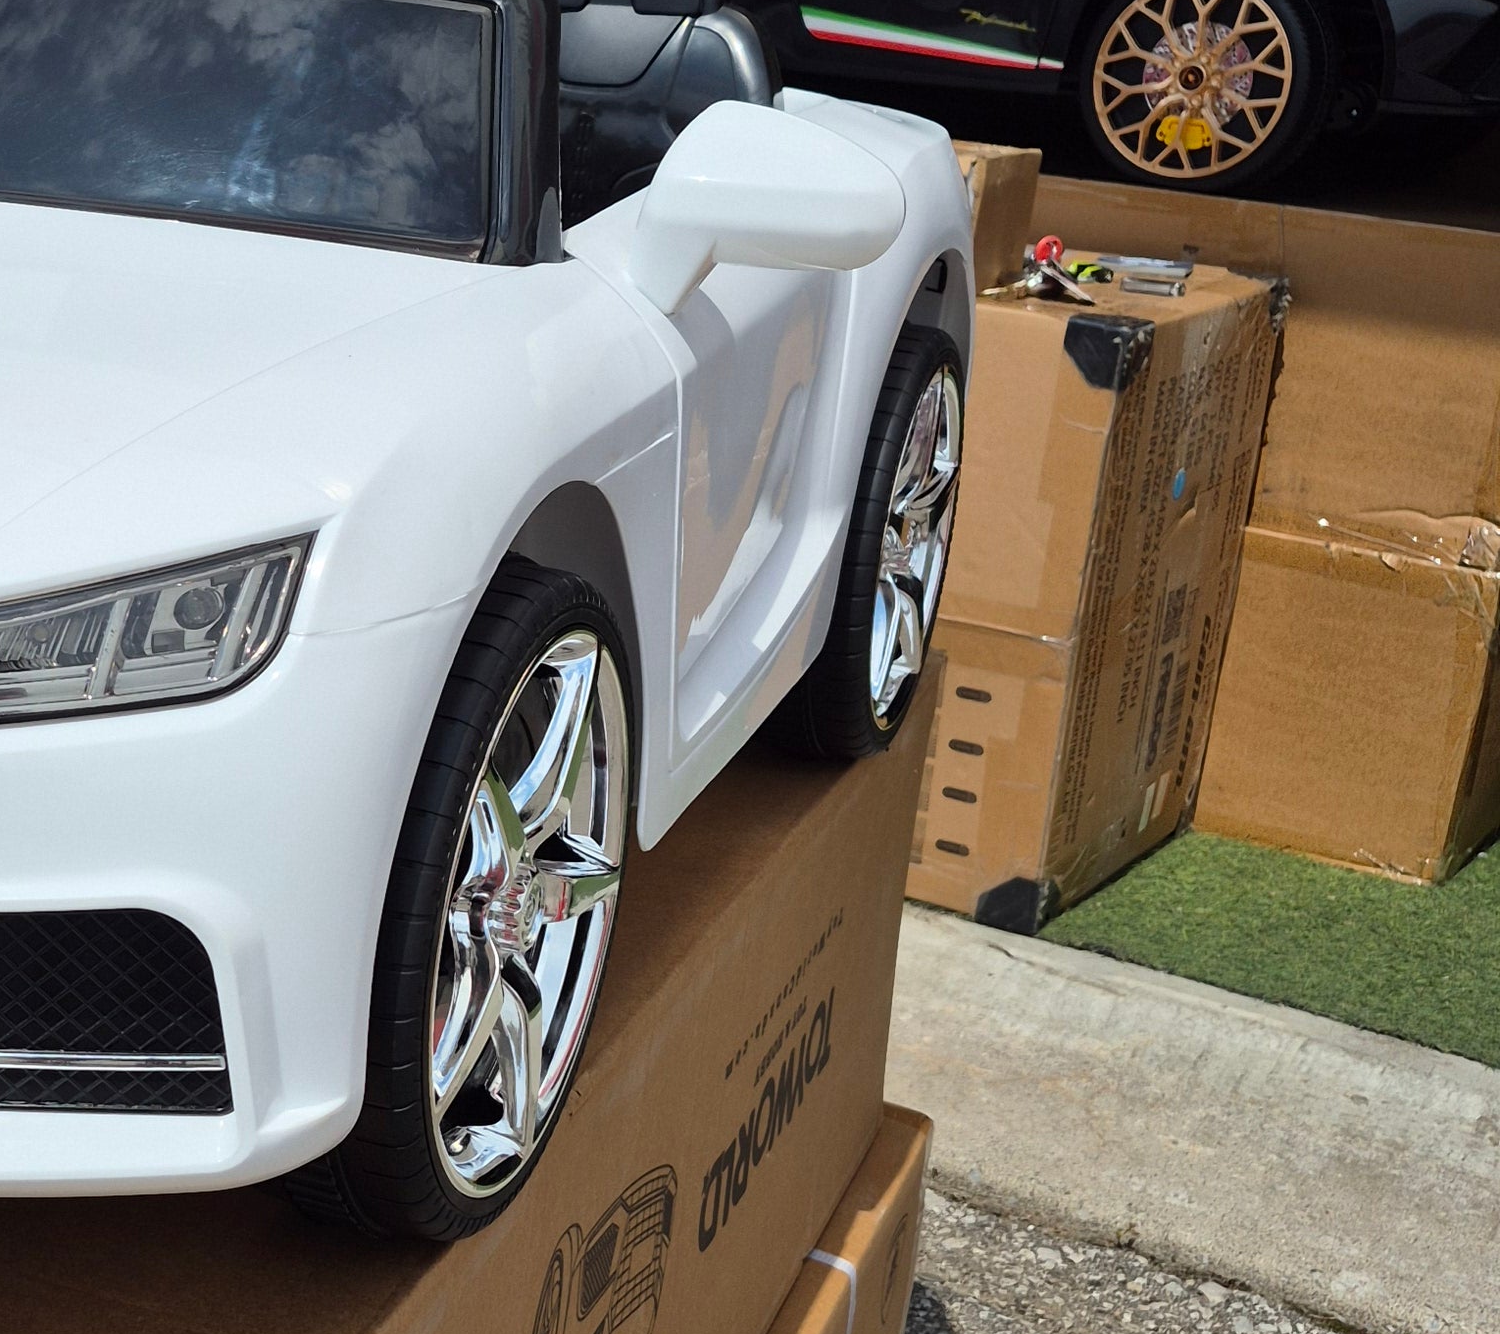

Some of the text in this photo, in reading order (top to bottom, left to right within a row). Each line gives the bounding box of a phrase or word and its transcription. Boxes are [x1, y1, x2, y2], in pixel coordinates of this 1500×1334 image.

[1151, 379, 1167, 432] MADE
[1138, 457, 1155, 514] CHINA
[697, 986, 834, 1253] TOYWORLD
